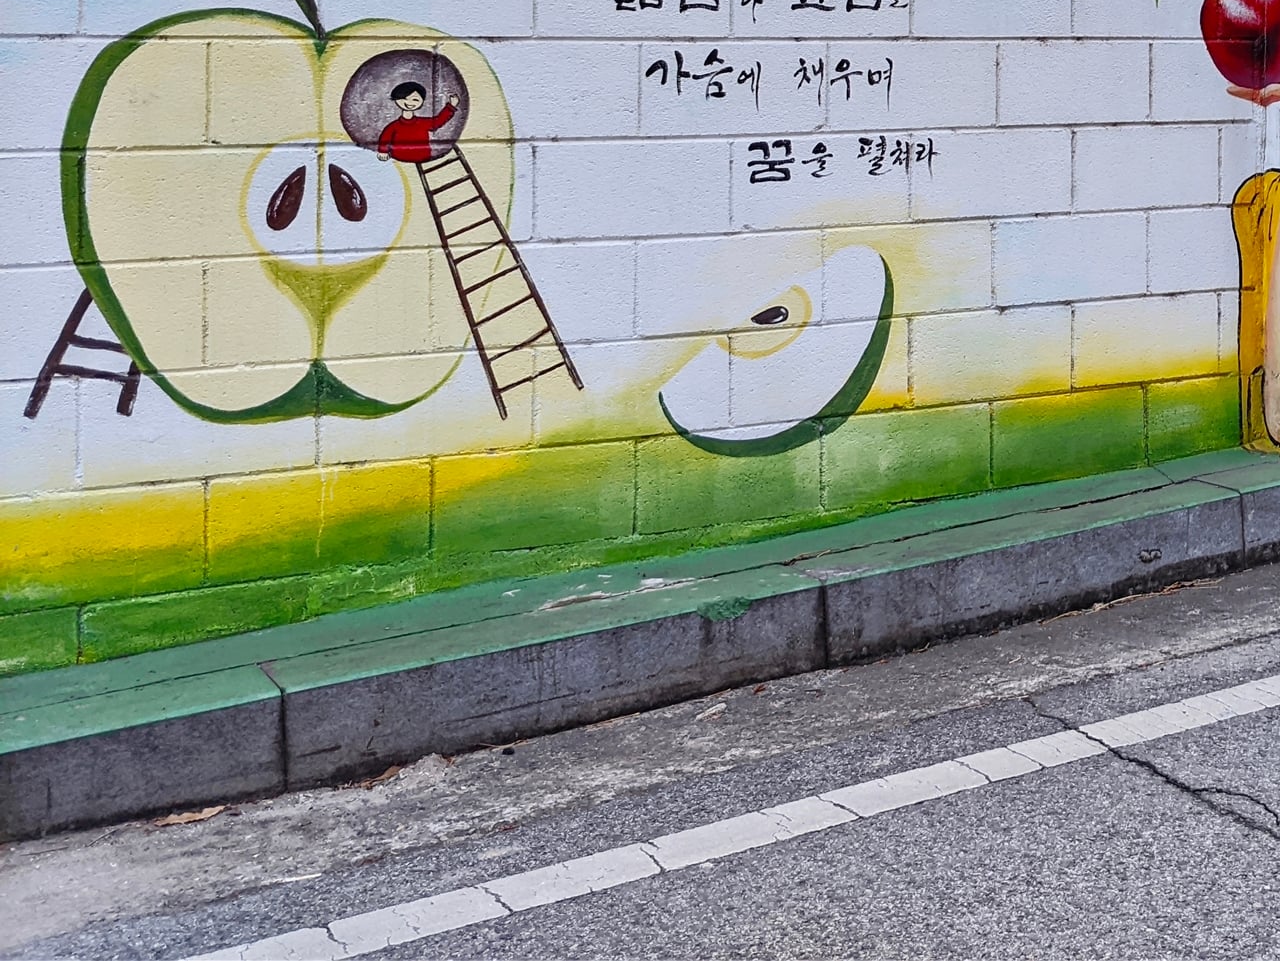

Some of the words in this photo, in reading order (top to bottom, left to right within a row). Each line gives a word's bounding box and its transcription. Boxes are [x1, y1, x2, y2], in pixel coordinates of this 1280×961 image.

[644, 48, 762, 111] 가슴에
[793, 56, 894, 111] 채우며
[747, 139, 833, 184] 꿈을
